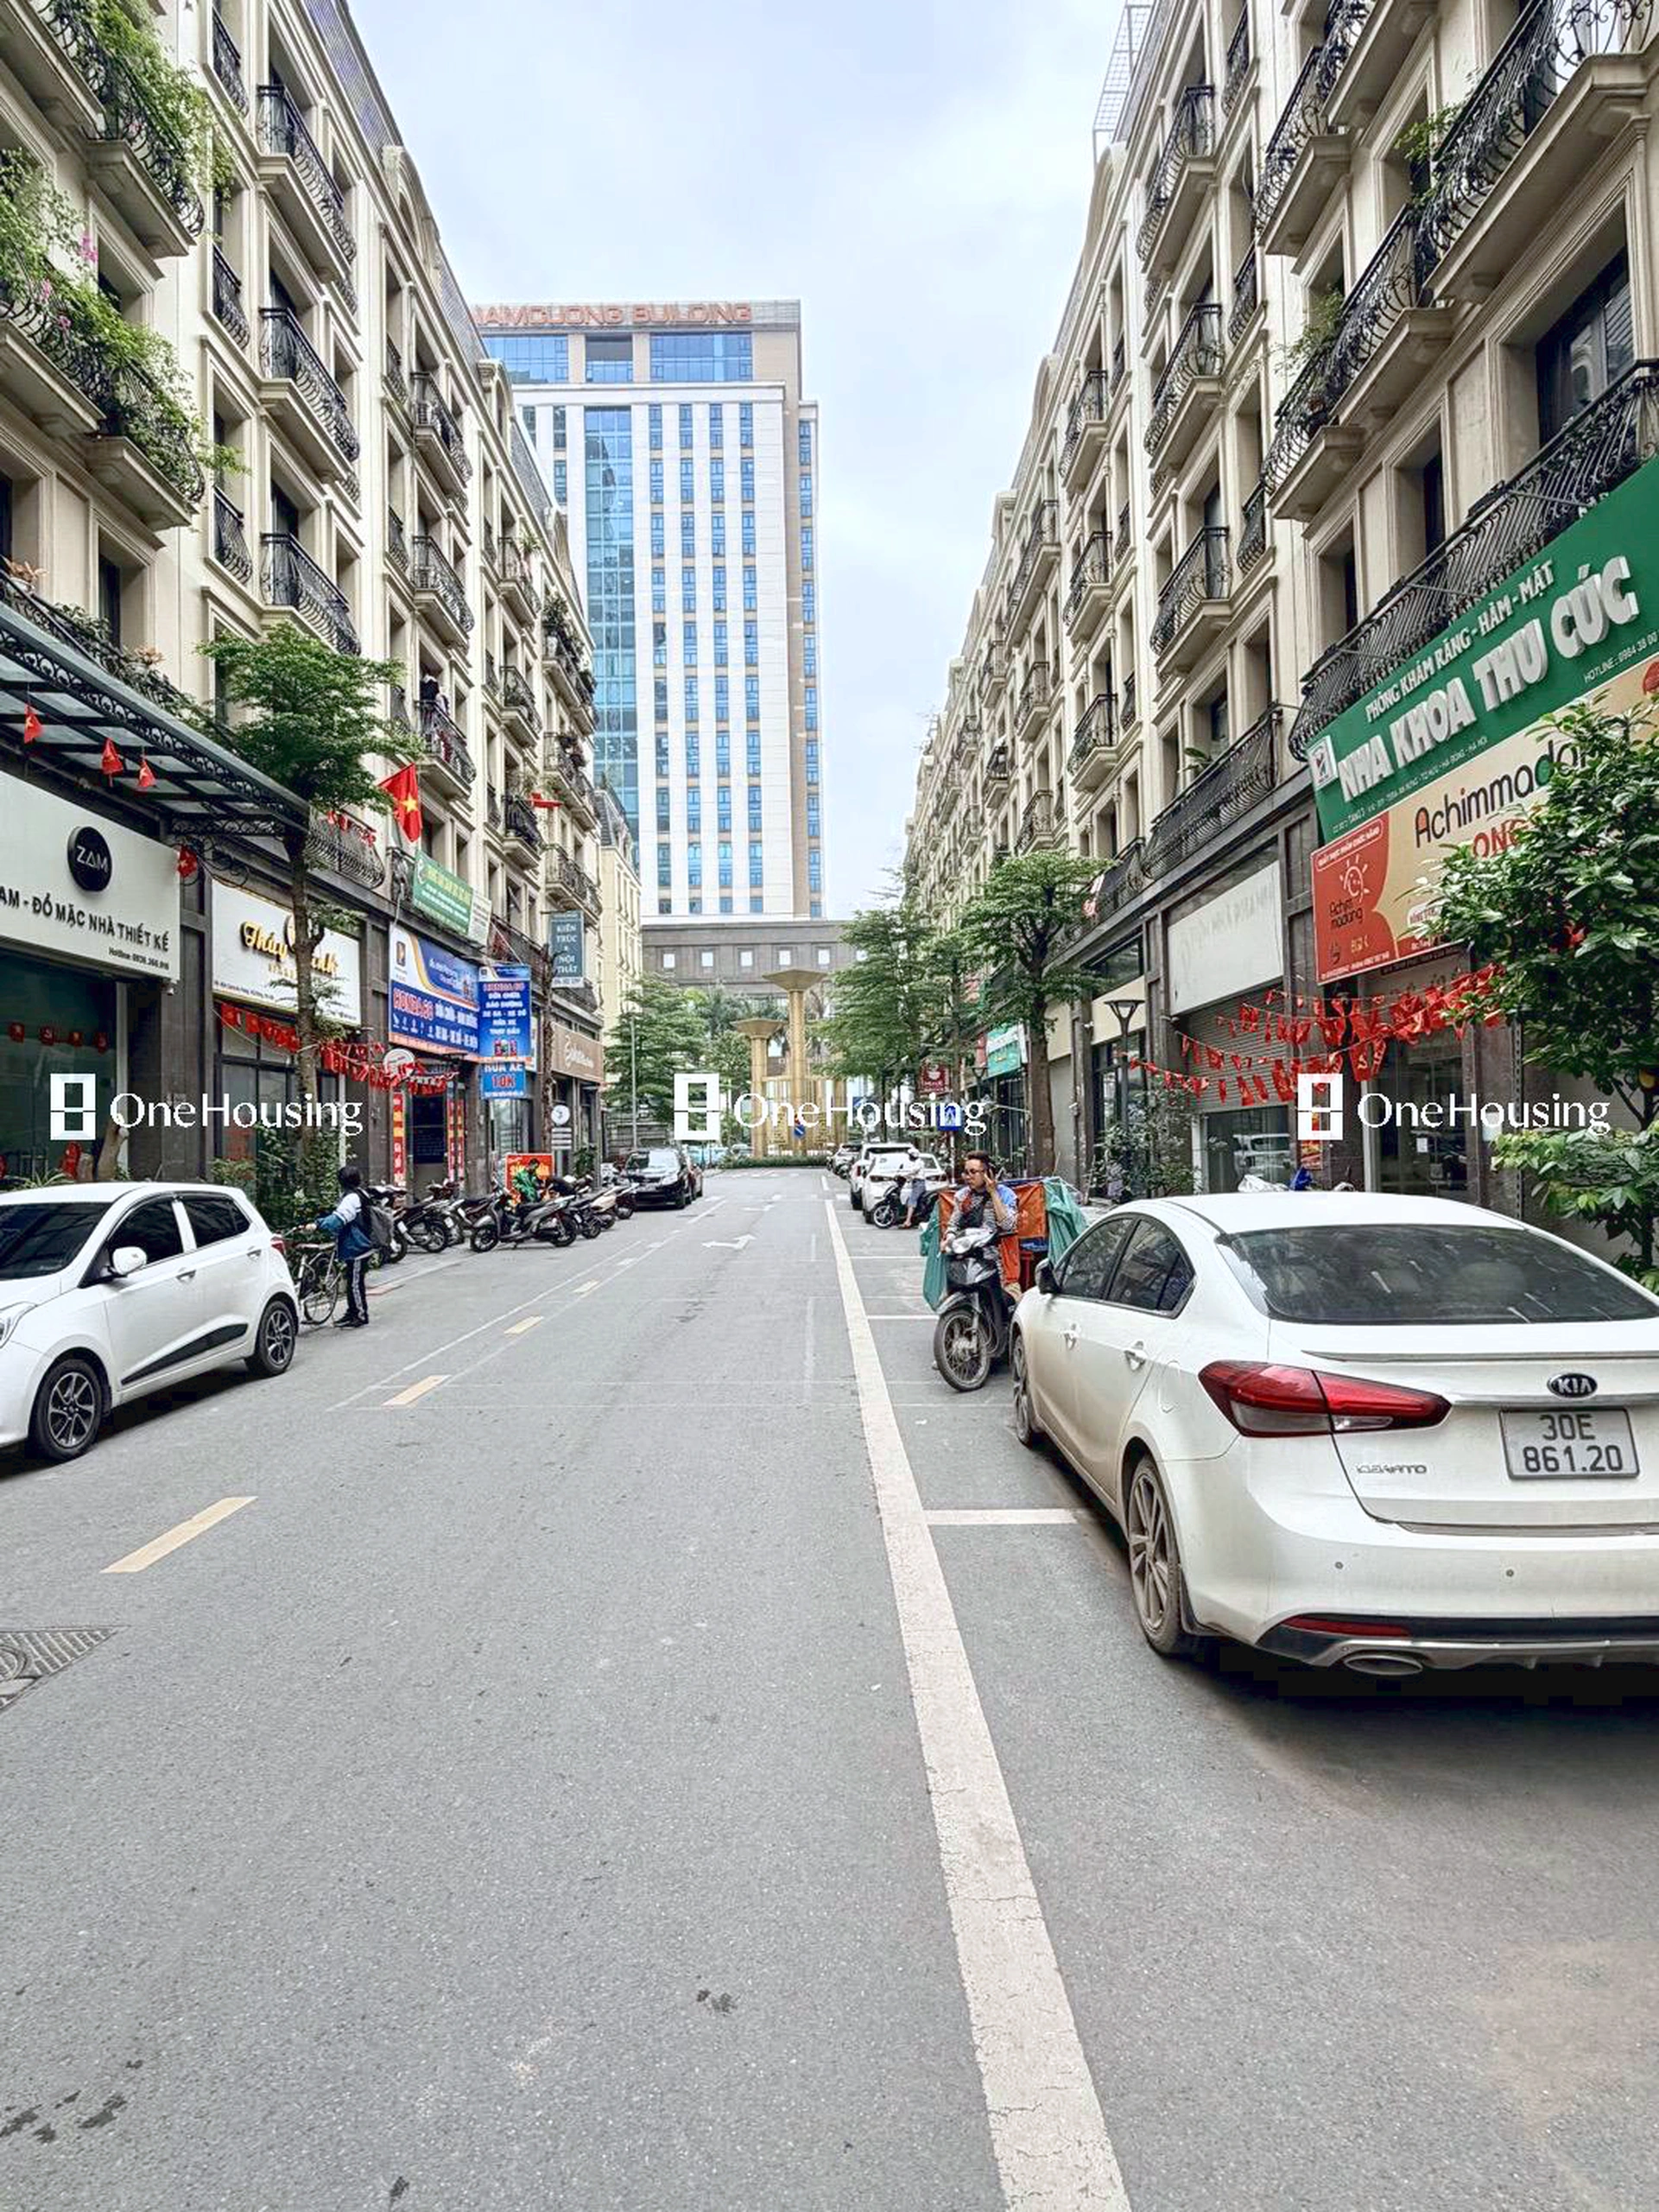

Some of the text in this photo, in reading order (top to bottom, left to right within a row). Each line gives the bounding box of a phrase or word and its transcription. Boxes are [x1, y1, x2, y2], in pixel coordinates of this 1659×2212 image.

[1337, 734, 1394, 803] NHA
[1389, 676, 1477, 769] KHOA
[1472, 618, 1548, 713] THU
[1558, 1377, 1592, 1394] KIA
[1539, 1414, 1595, 1441] 30E
[1523, 1445, 1623, 1474] 861.20
